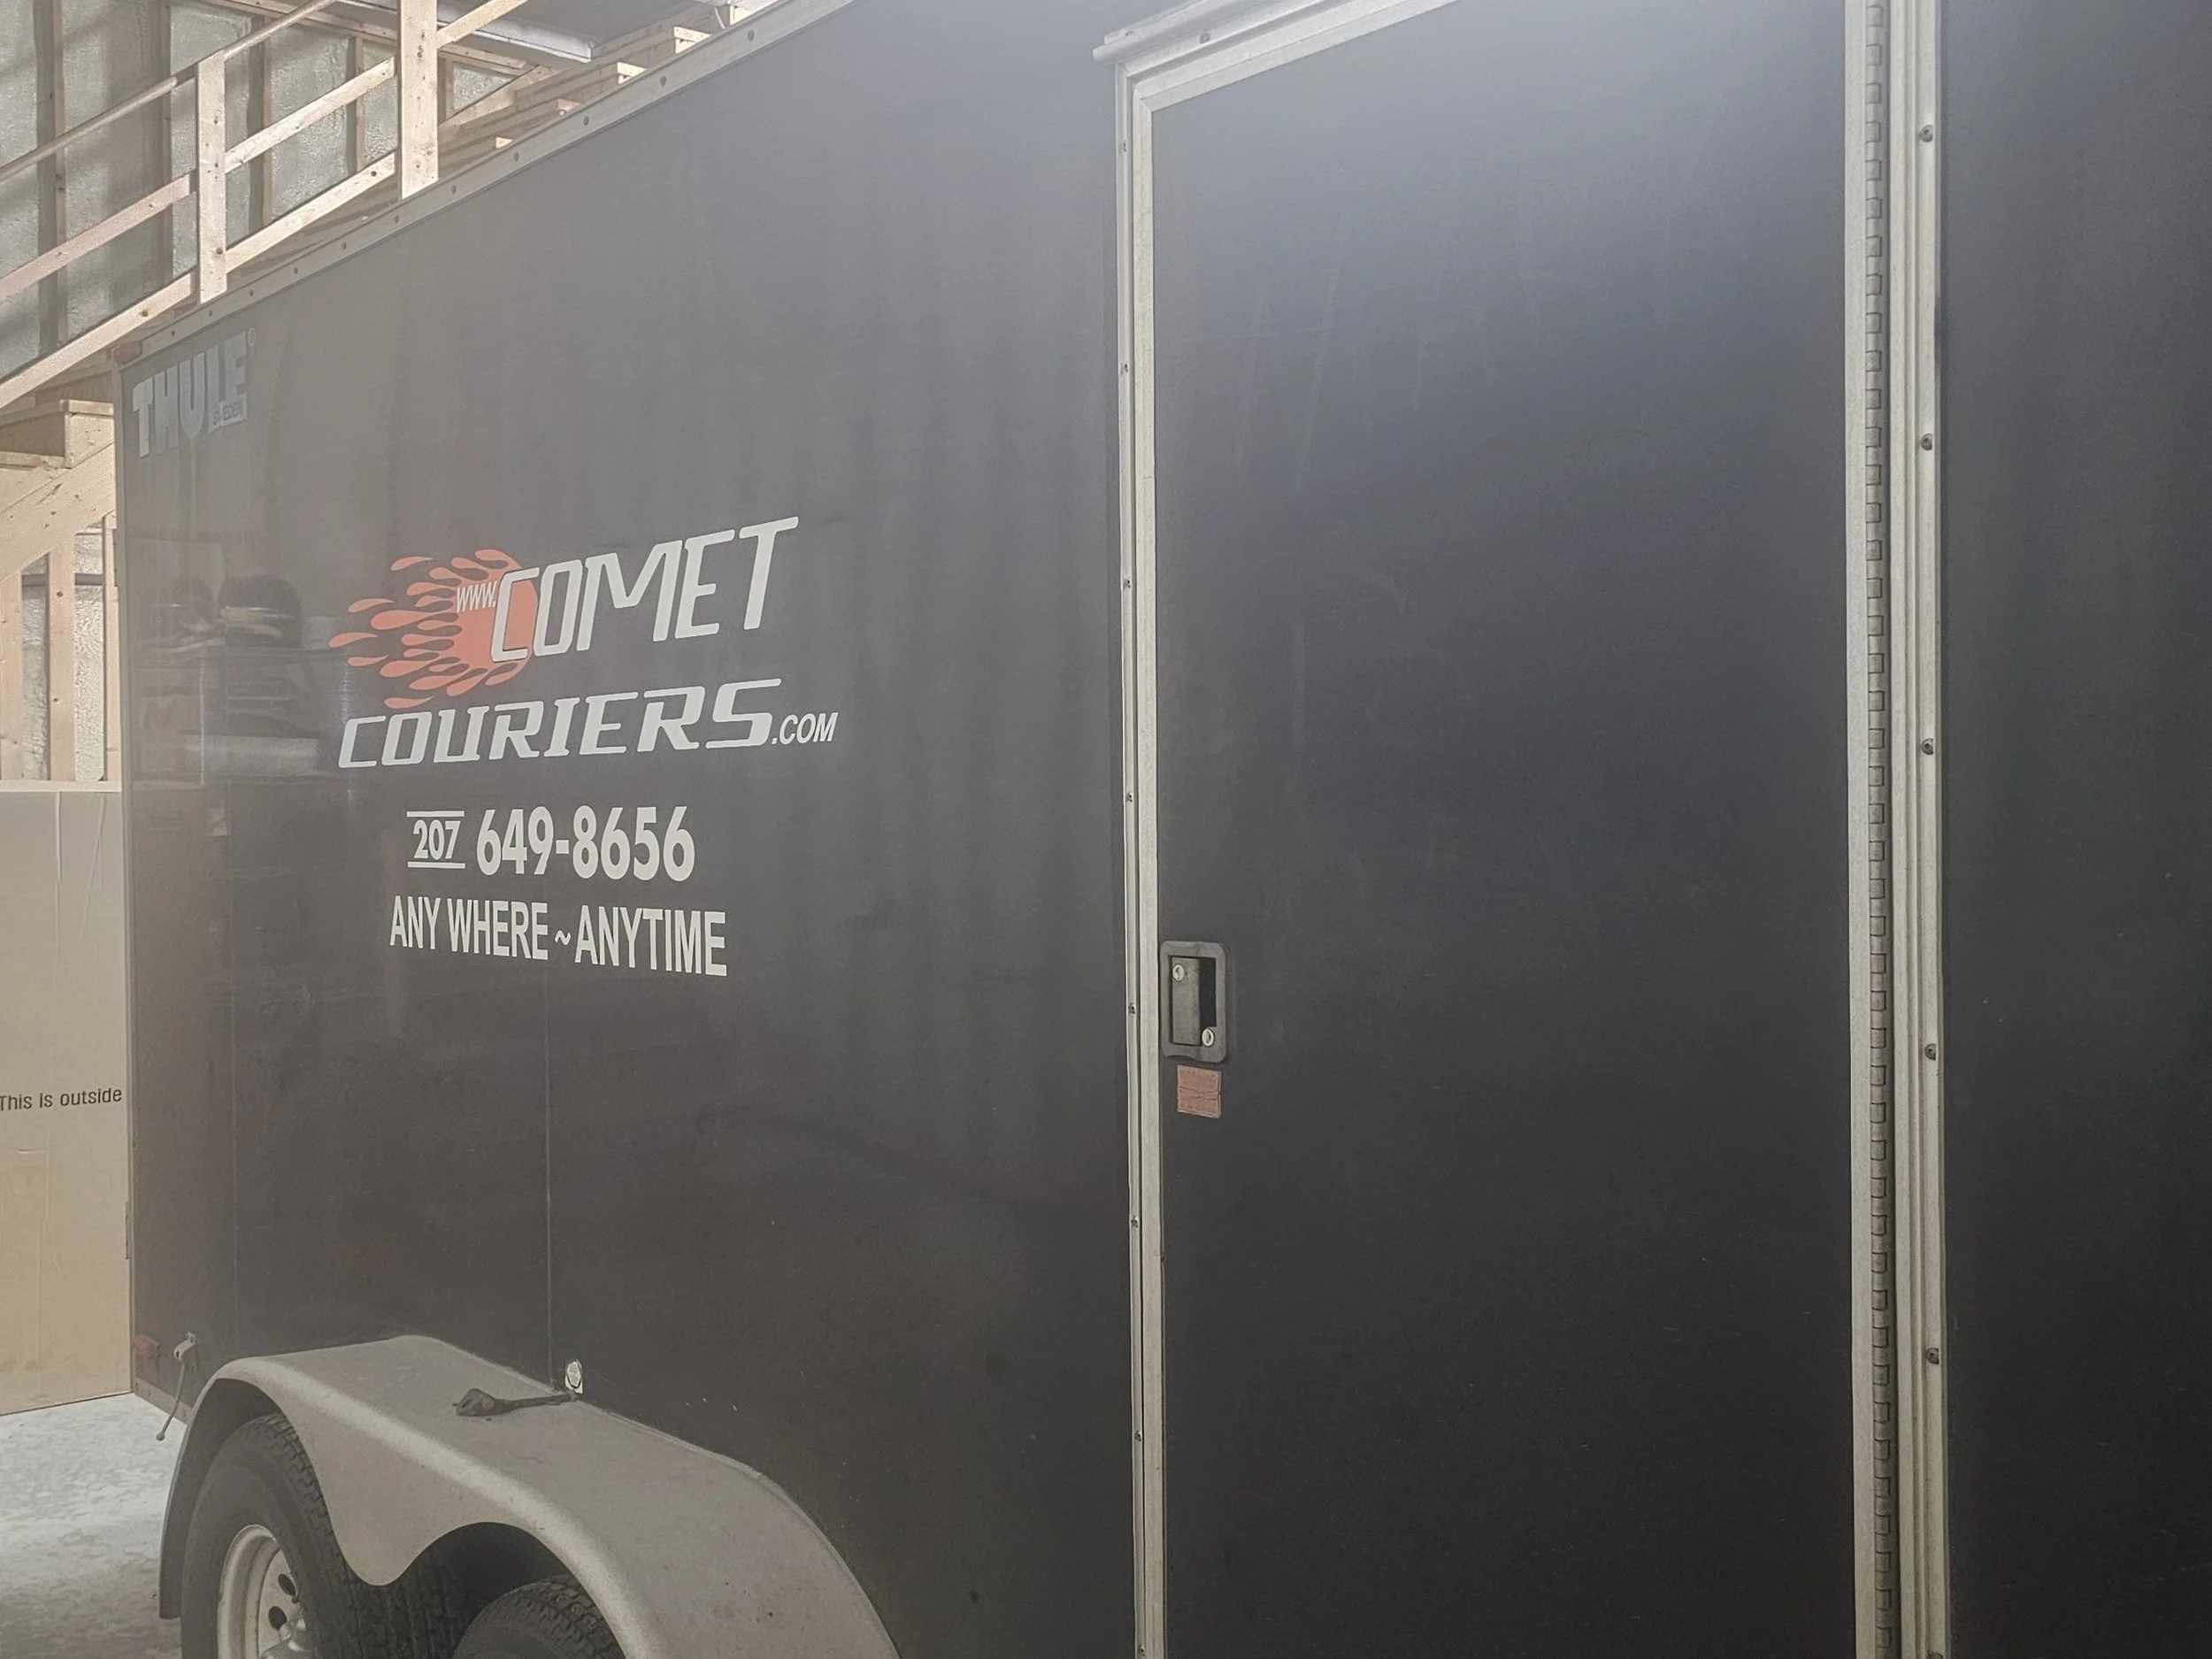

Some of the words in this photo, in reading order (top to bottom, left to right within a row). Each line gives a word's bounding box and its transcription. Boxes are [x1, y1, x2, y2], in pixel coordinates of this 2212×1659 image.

[491, 516, 799, 662] COMET
[337, 678, 782, 768] COURIERS
[412, 819, 461, 860] 207
[476, 804, 695, 882] 649-8656
[389, 895, 441, 949] ANY
[446, 898, 549, 961] WHERE
[574, 904, 728, 977] ANYTIME
[0, 1094, 33, 1111] This
[39, 1093, 53, 1108] is
[59, 1087, 123, 1106] outside
